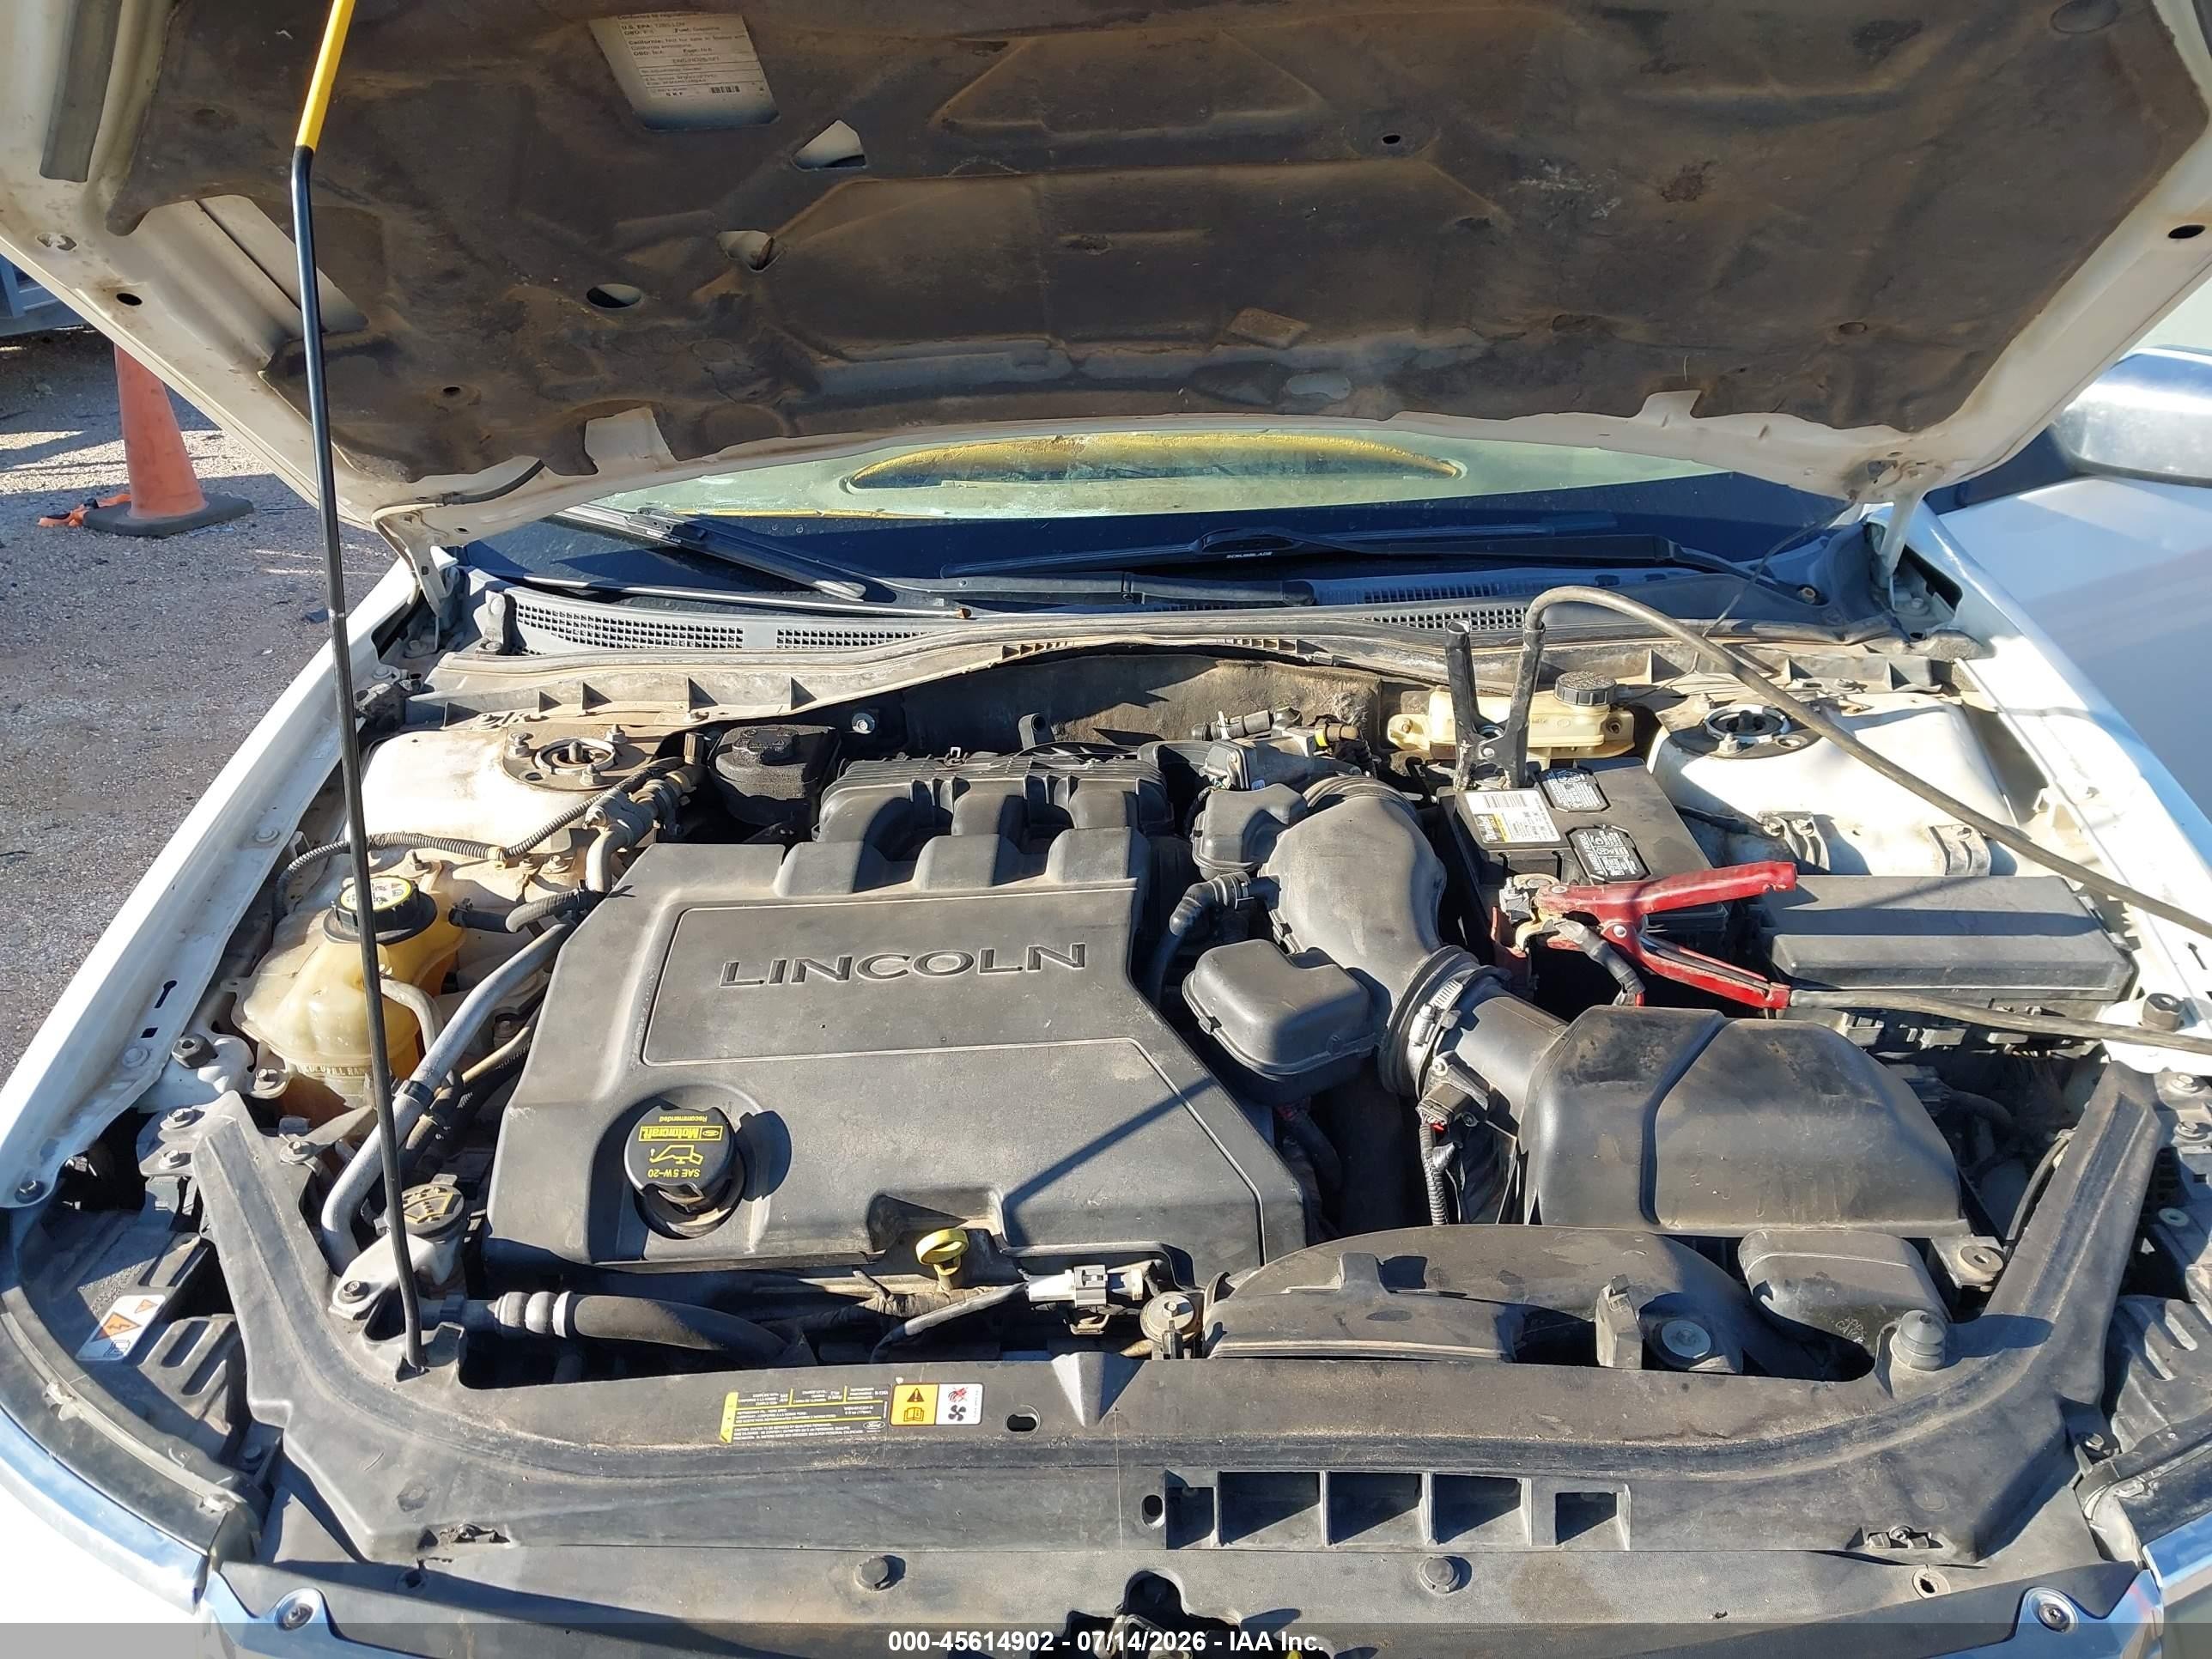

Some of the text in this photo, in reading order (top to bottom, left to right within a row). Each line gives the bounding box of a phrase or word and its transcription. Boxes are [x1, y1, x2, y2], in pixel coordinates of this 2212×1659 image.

[720, 943, 1086, 988] LINCOLN
[642, 1127, 699, 1139] Motorcraft
[647, 1168, 701, 1178] SAE 5W-20
